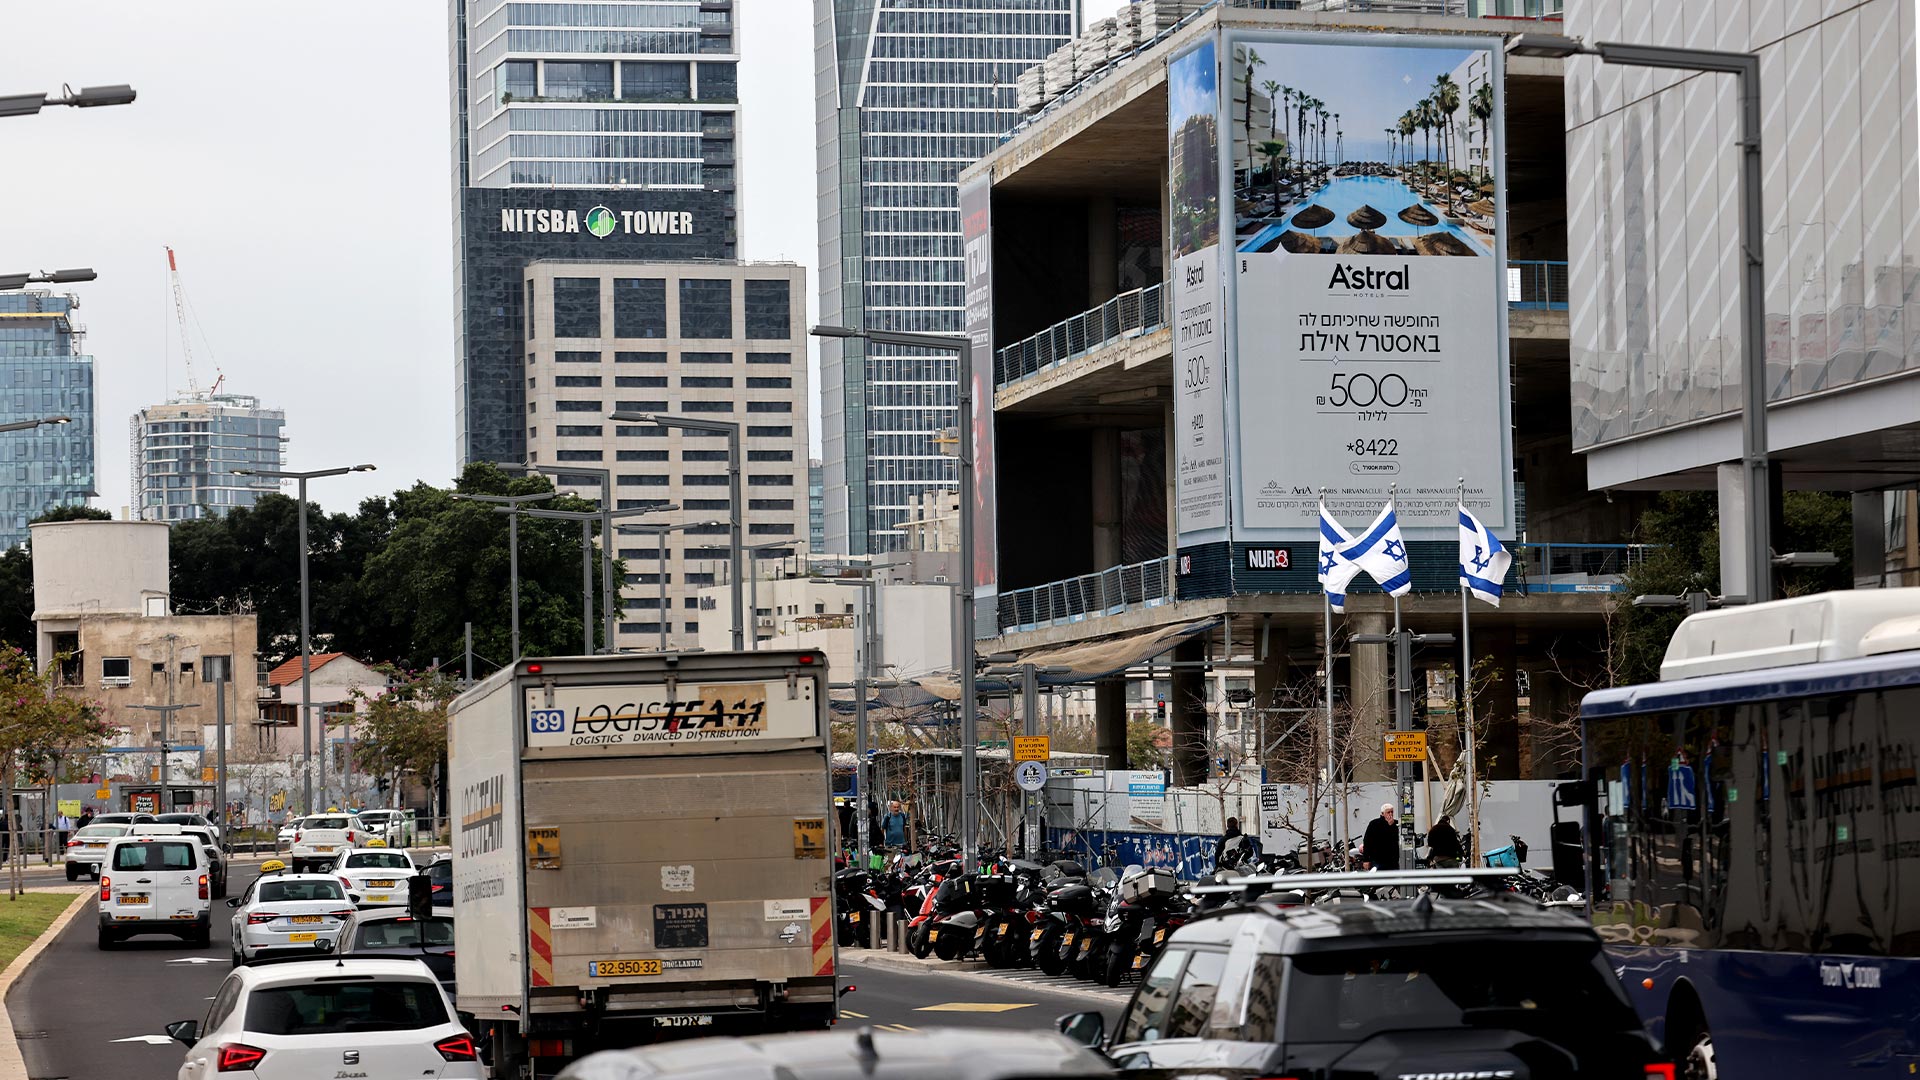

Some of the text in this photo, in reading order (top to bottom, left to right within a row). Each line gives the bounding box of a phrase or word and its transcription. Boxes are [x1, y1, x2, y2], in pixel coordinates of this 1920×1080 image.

[501, 208, 693, 235] NITSBA TOWER
[1328, 263, 1409, 291] Astral
[1299, 312, 1440, 328] החופשה שחיכיתם לה
[1299, 330, 1441, 353] באסטרל אילת
[1329, 373, 1408, 408] 500
[1408, 388, 1428, 398] החל
[1358, 410, 1388, 421] ללילה
[535, 711, 562, 732] 89
[569, 734, 624, 746] LOGISTICS
[686, 728, 761, 741] DISTRIBUTION
[795, 821, 822, 830] אמיר
[529, 830, 558, 839] אמיר
[667, 907, 706, 919] אמיר
[334, 1070, 368, 1079] Ibiza
